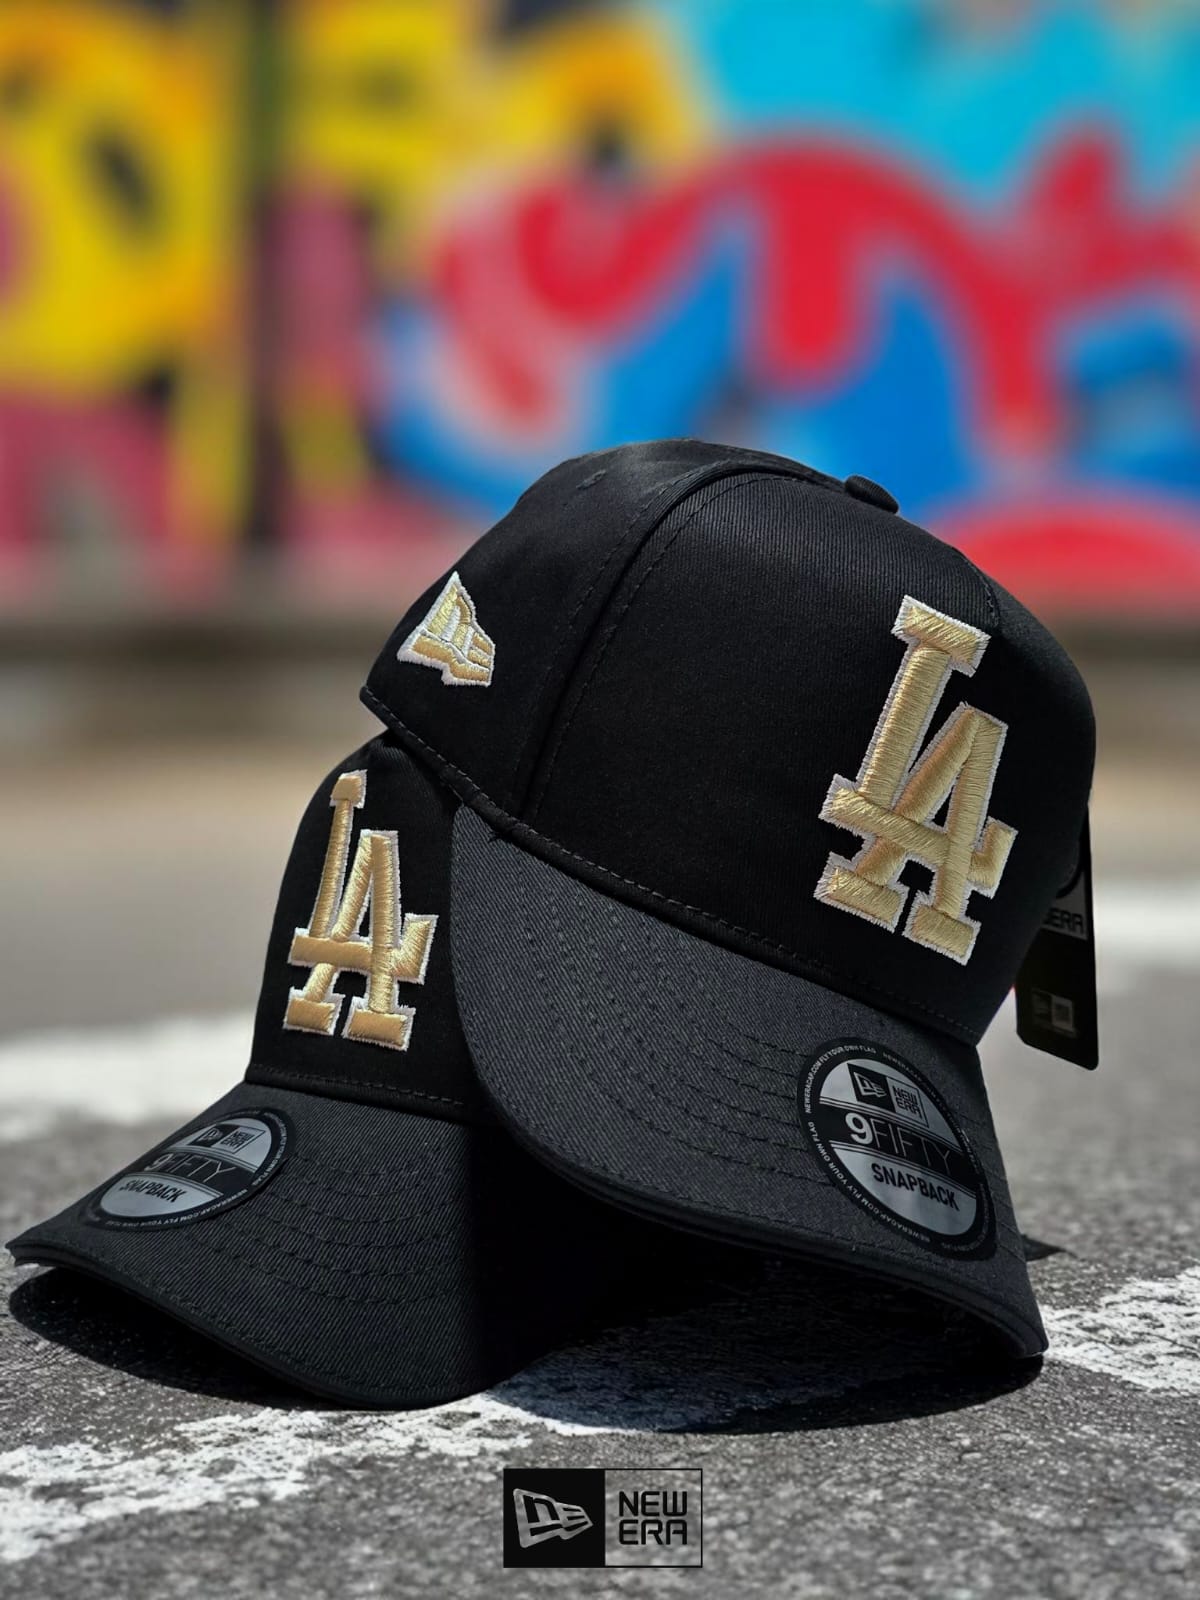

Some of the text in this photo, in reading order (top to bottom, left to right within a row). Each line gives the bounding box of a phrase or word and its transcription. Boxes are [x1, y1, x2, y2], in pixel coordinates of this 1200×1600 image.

[813, 594, 1018, 966] LA
[283, 769, 439, 1051] LA
[892, 1085, 919, 1105] NEW
[896, 1097, 923, 1119] ERA
[816, 1143, 831, 1162] OWN
[845, 1112, 951, 1176] 9FIFTY
[828, 1162, 849, 1185] YOUR
[120, 1179, 188, 1203] SNAPBACK
[871, 1163, 960, 1211] SNAPBACK
